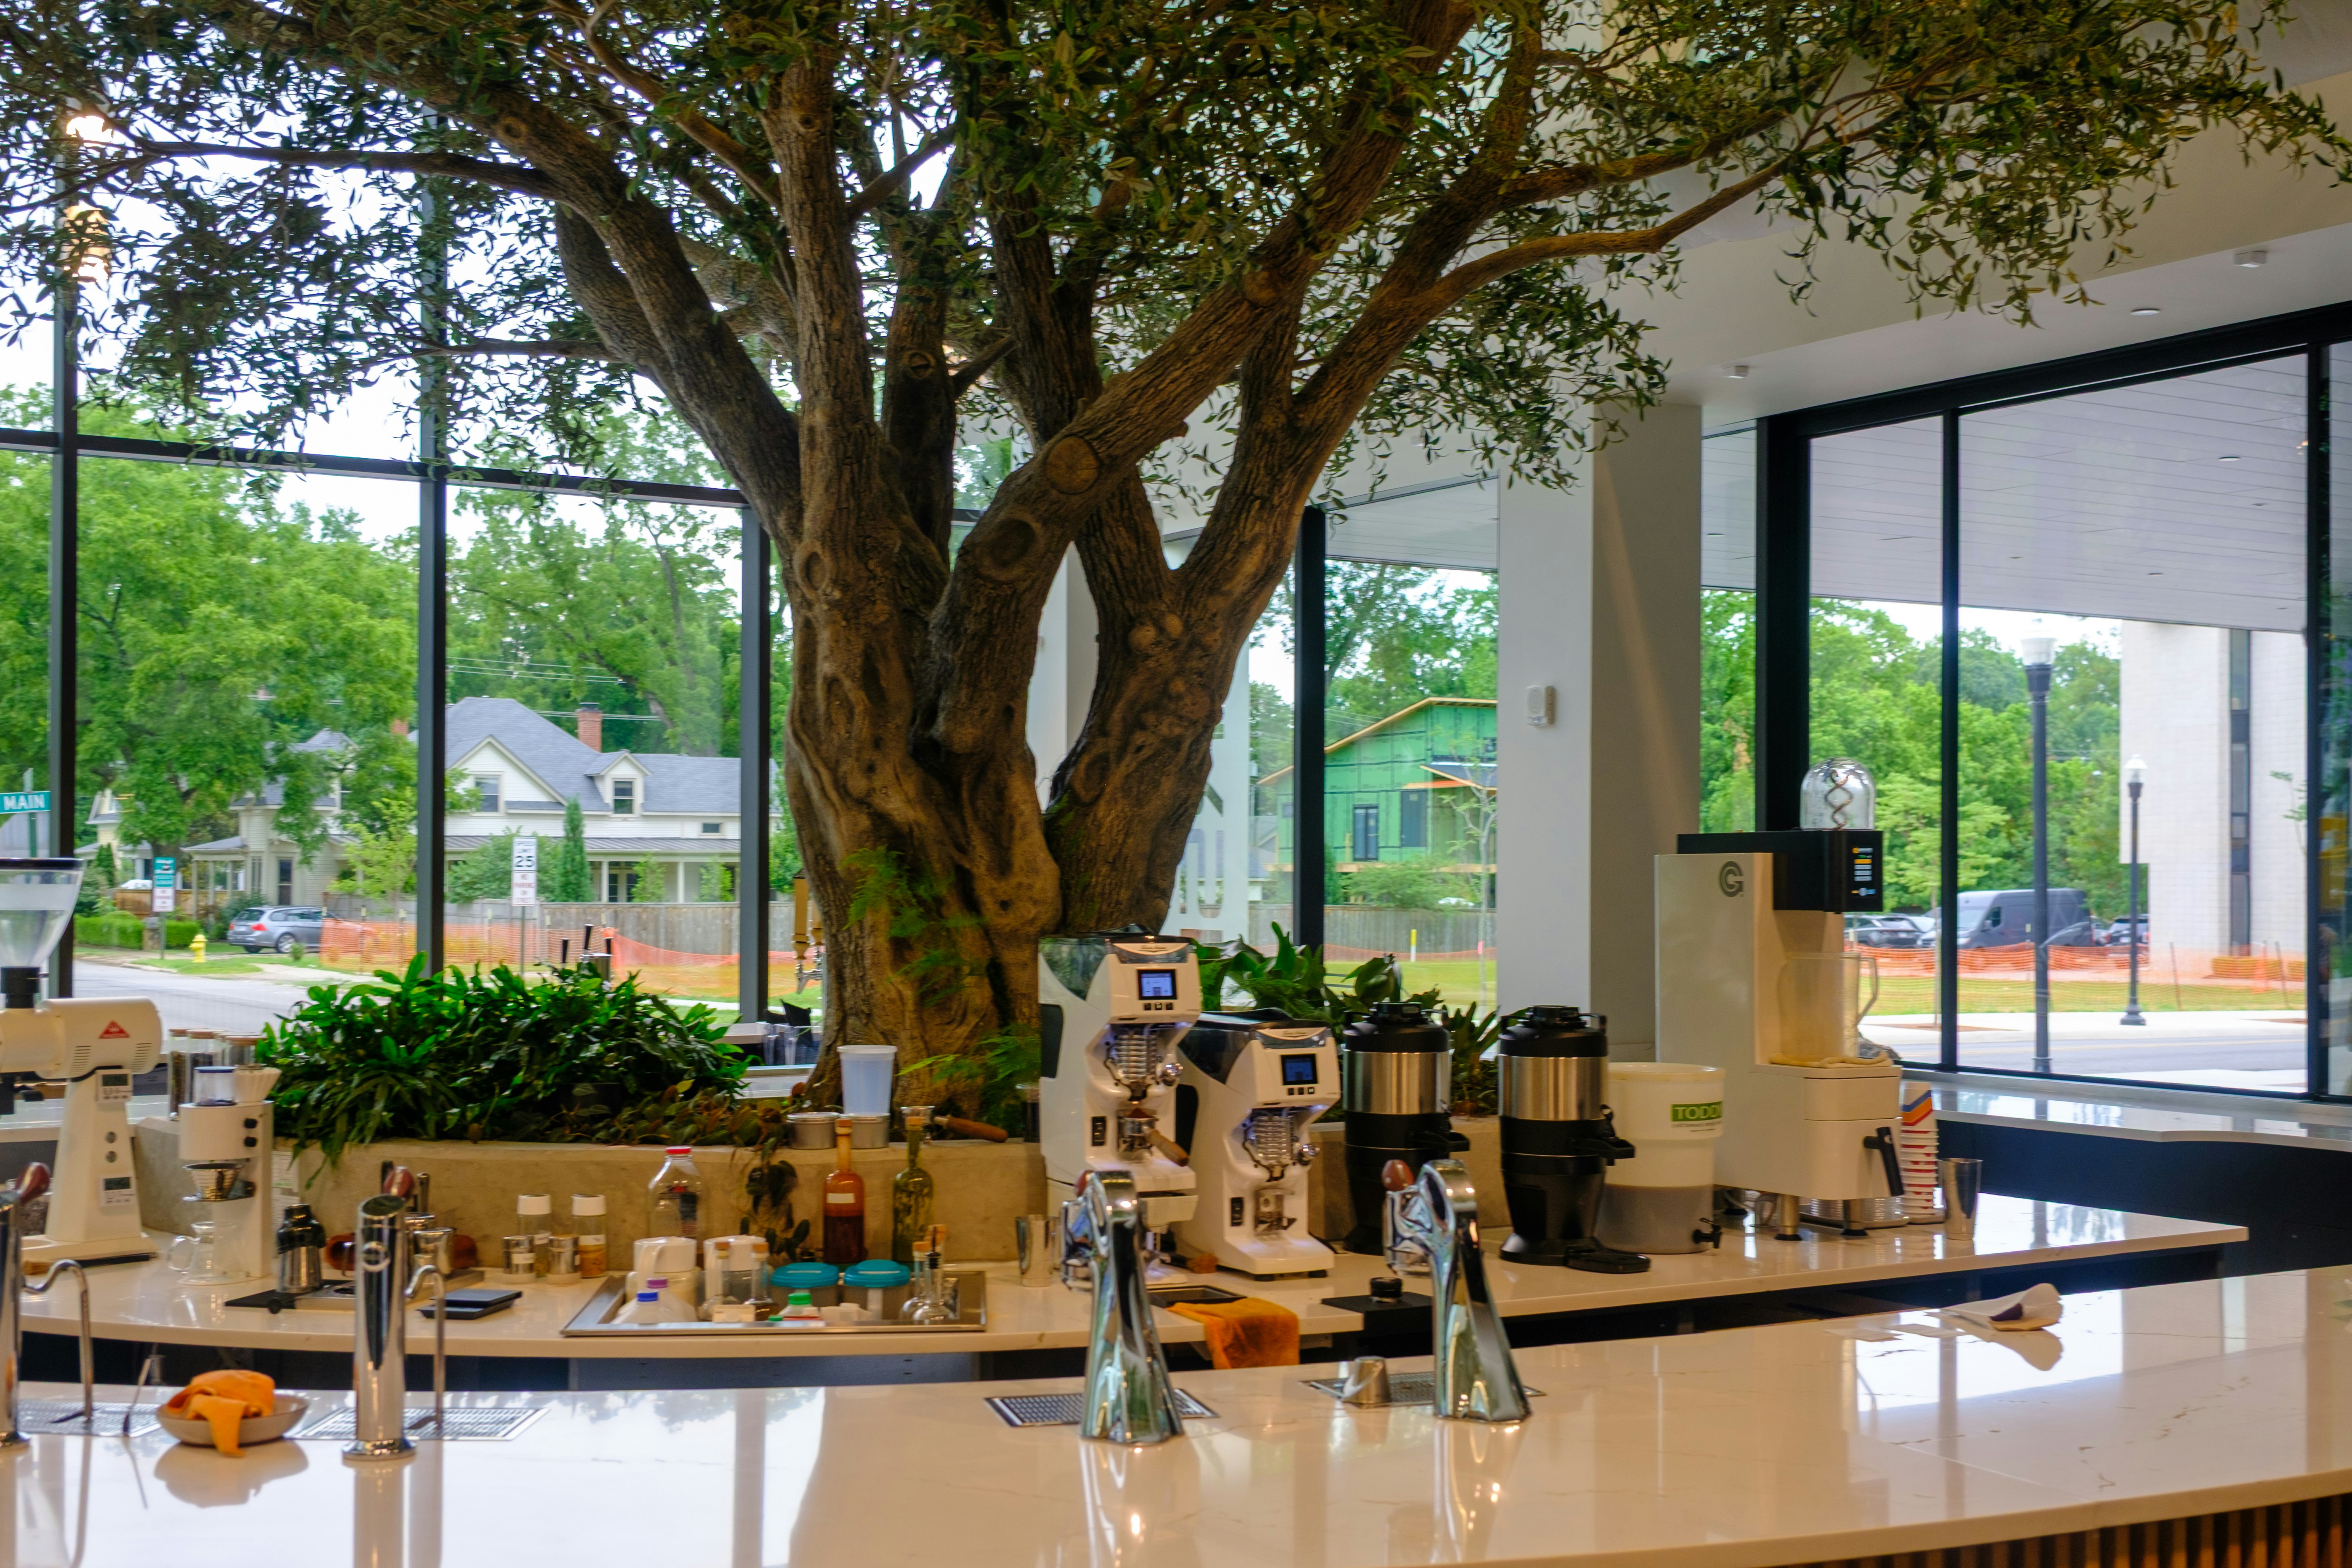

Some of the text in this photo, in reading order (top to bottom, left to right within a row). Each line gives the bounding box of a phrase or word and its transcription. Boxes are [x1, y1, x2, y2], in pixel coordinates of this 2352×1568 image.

[3, 794, 45, 810] MAIN
[515, 856, 535, 867] 25
[1673, 1105, 1722, 1119] TODD
